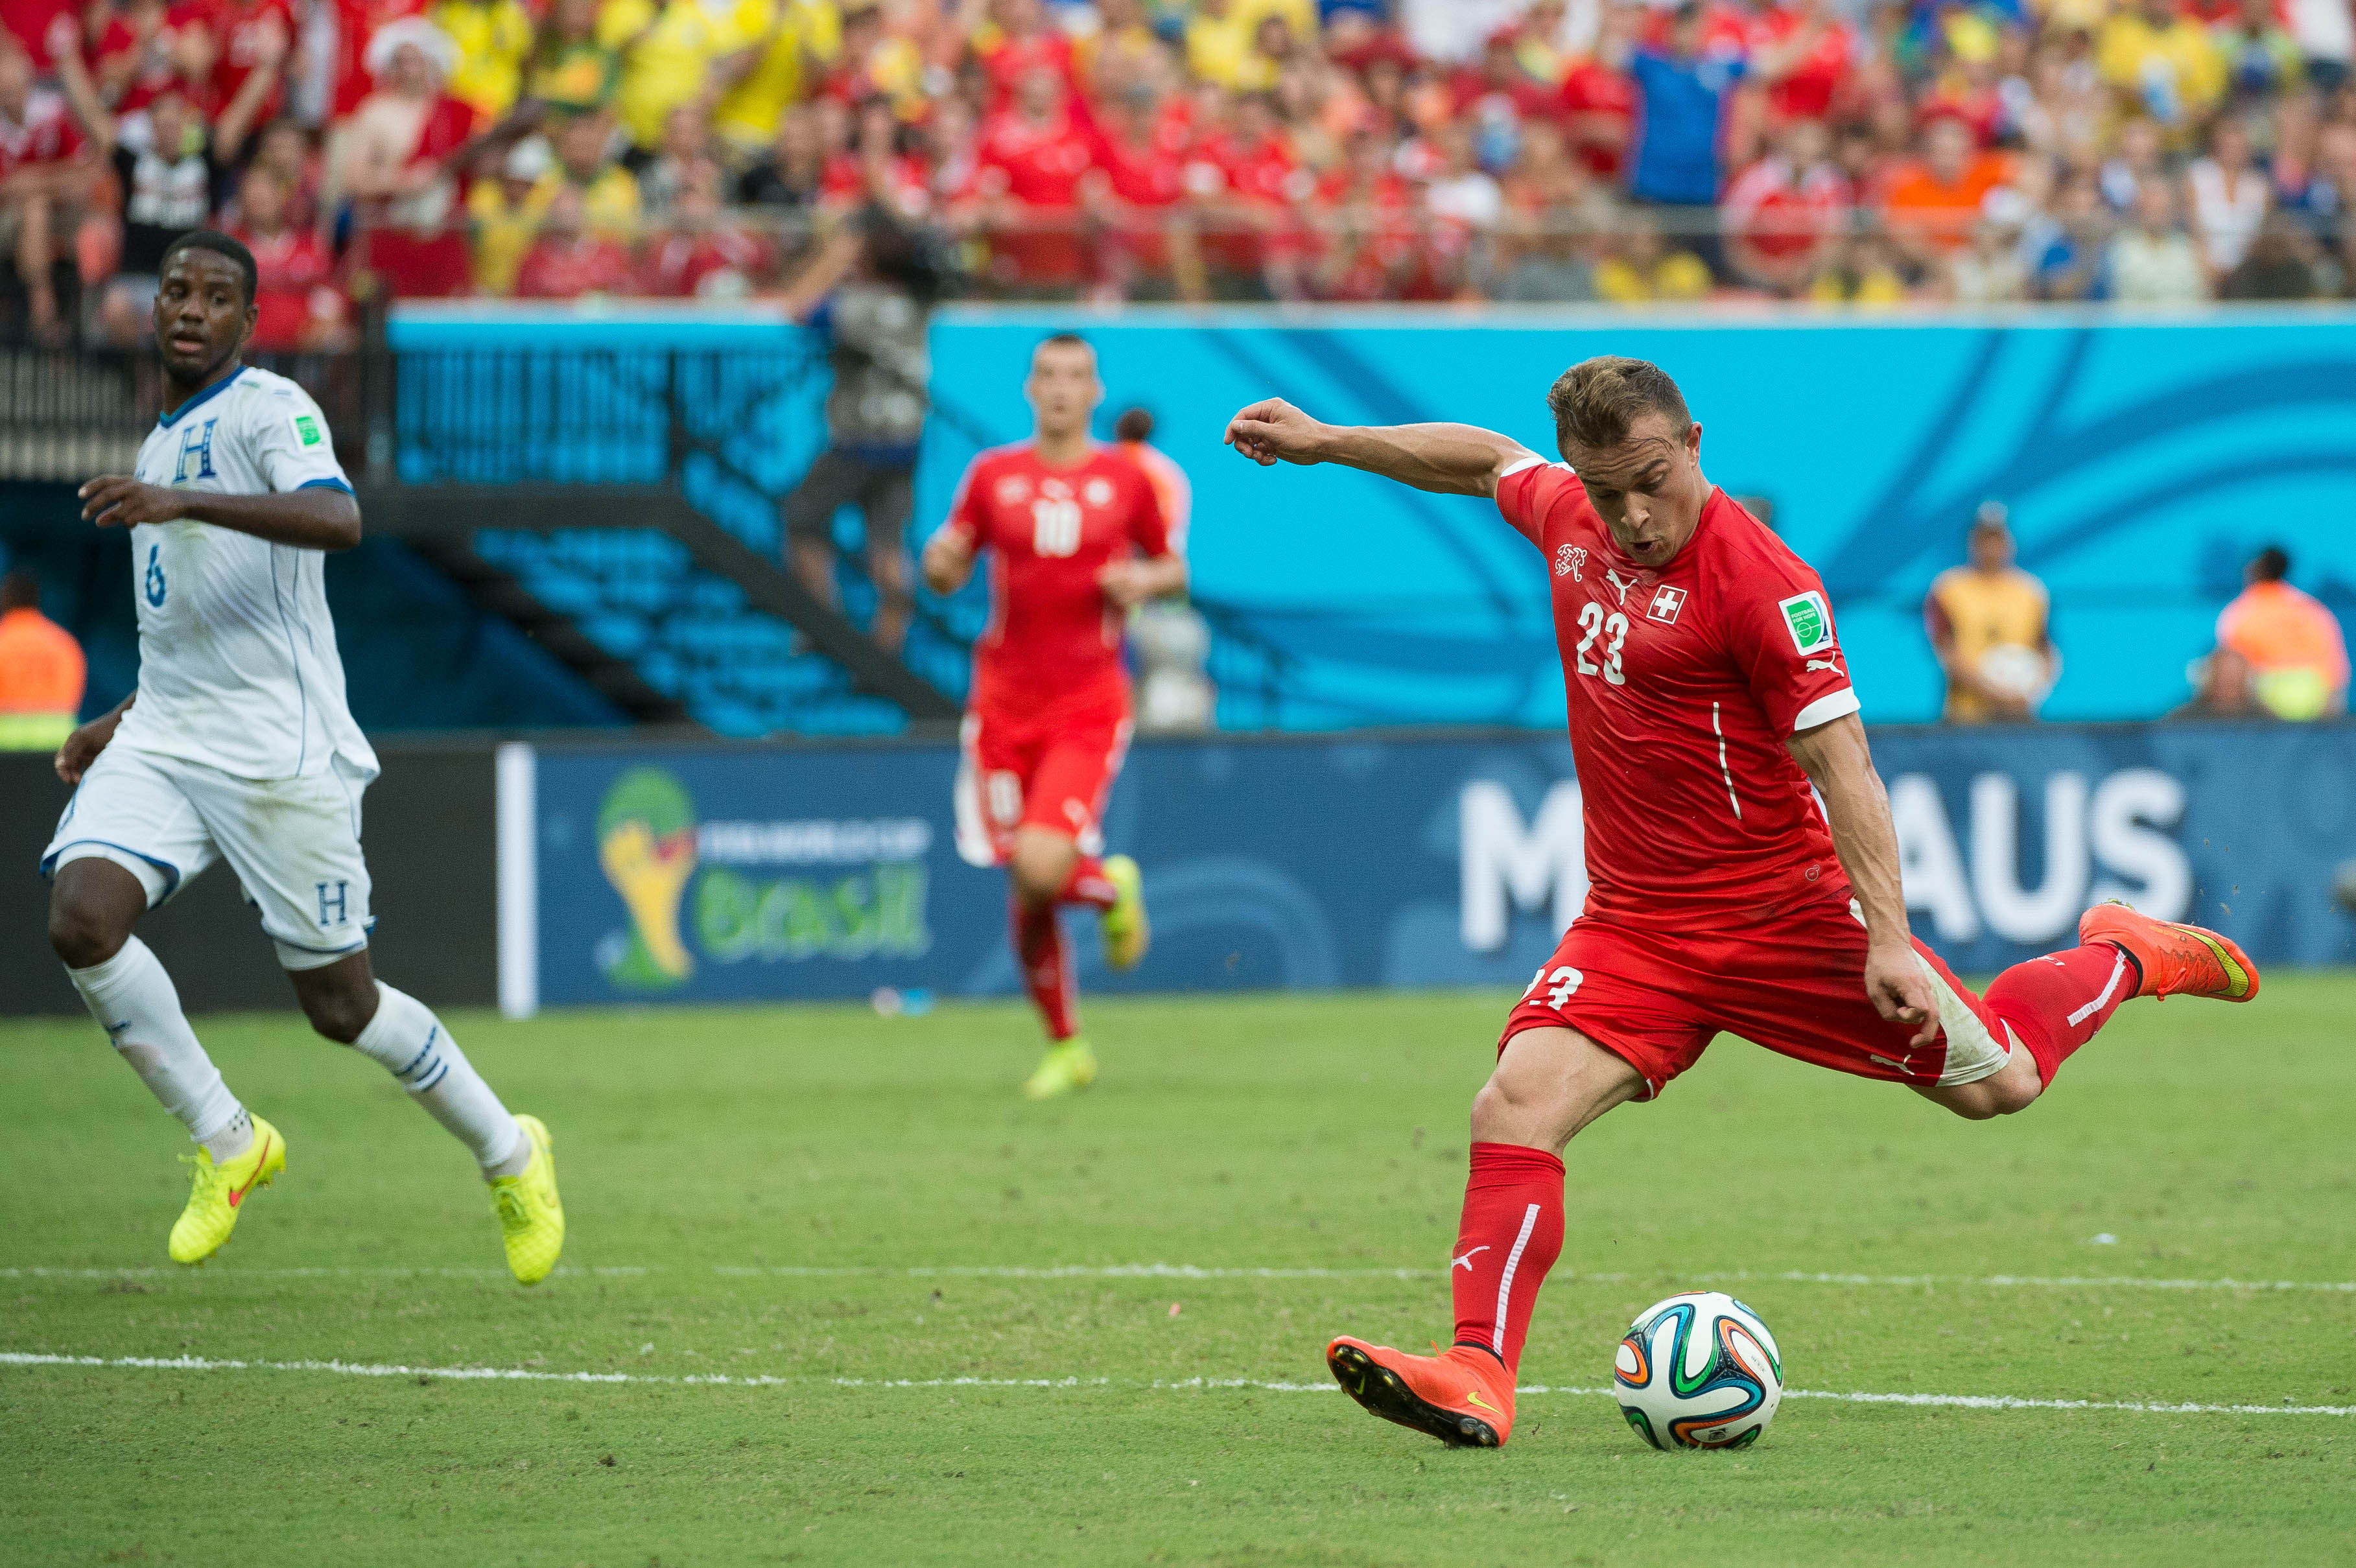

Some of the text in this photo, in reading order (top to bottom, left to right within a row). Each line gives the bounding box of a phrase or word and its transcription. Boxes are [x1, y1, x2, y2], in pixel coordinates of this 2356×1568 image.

[172, 417, 218, 484] H
[1031, 497, 1083, 558] 10
[145, 543, 166, 608] 6
[1576, 601, 1629, 685] 23
[1791, 607, 1815, 618] FOOTBALL
[1460, 769, 2192, 949] MAUS
[315, 880, 349, 926] H
